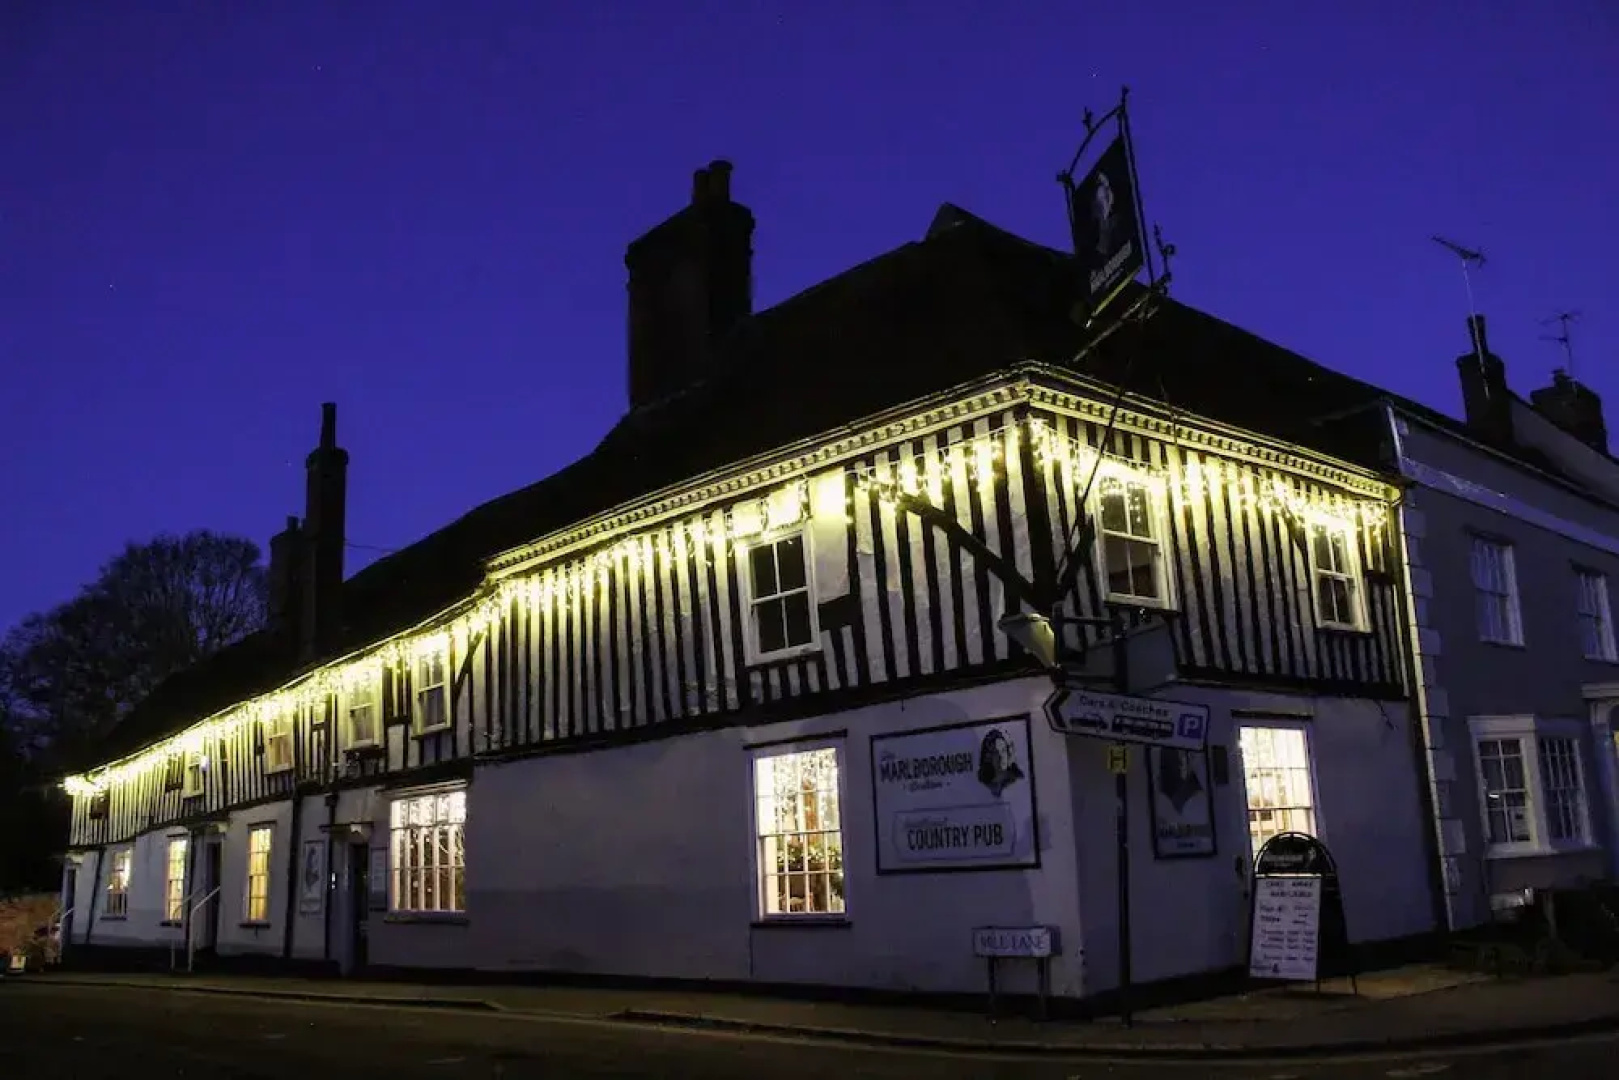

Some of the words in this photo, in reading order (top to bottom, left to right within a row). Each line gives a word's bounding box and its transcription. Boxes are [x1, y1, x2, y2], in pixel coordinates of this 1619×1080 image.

[1121, 699, 1169, 717] Coaches
[1184, 716, 1198, 735] P
[880, 752, 973, 782] MARLBOROUGH
[1110, 747, 1126, 769] H
[907, 825, 969, 850] COUNTRY
[974, 823, 1003, 848] PUB
[1012, 934, 1047, 950] LANE
